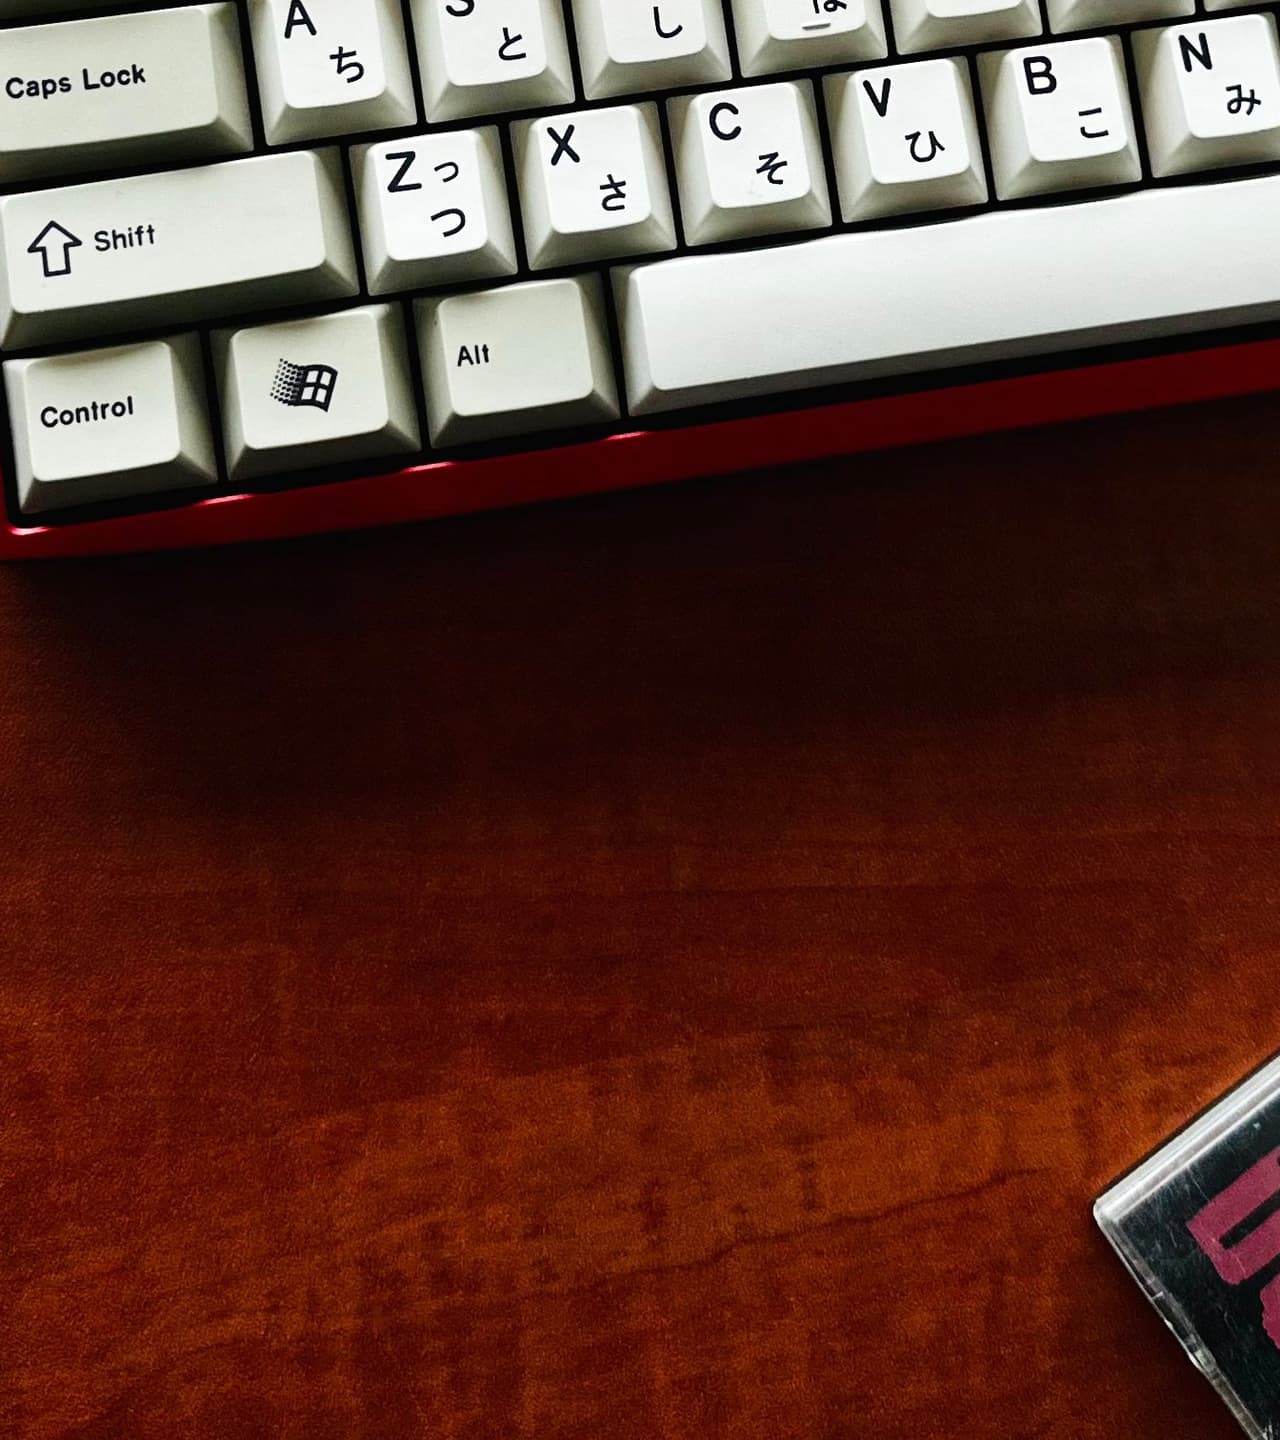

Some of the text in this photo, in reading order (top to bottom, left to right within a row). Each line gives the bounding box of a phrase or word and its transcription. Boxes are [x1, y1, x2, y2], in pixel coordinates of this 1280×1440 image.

[652, 6, 683, 39] し
[498, 27, 527, 61] と
[1177, 32, 1213, 73] N
[5, 63, 146, 100] Caps Lock
[329, 46, 365, 84] ち
[1022, 55, 1058, 96] B
[862, 77, 892, 118] V
[1225, 84, 1262, 116] み
[708, 101, 742, 141] C
[1078, 107, 1110, 139] こ
[546, 124, 581, 167] X
[904, 130, 946, 163] ひ
[384, 150, 423, 194] Z
[755, 151, 788, 186] そ
[599, 173, 627, 212] さ
[93, 224, 155, 252] Shift
[430, 207, 466, 238] つ
[457, 343, 490, 367] Alt
[40, 395, 134, 428] Control
